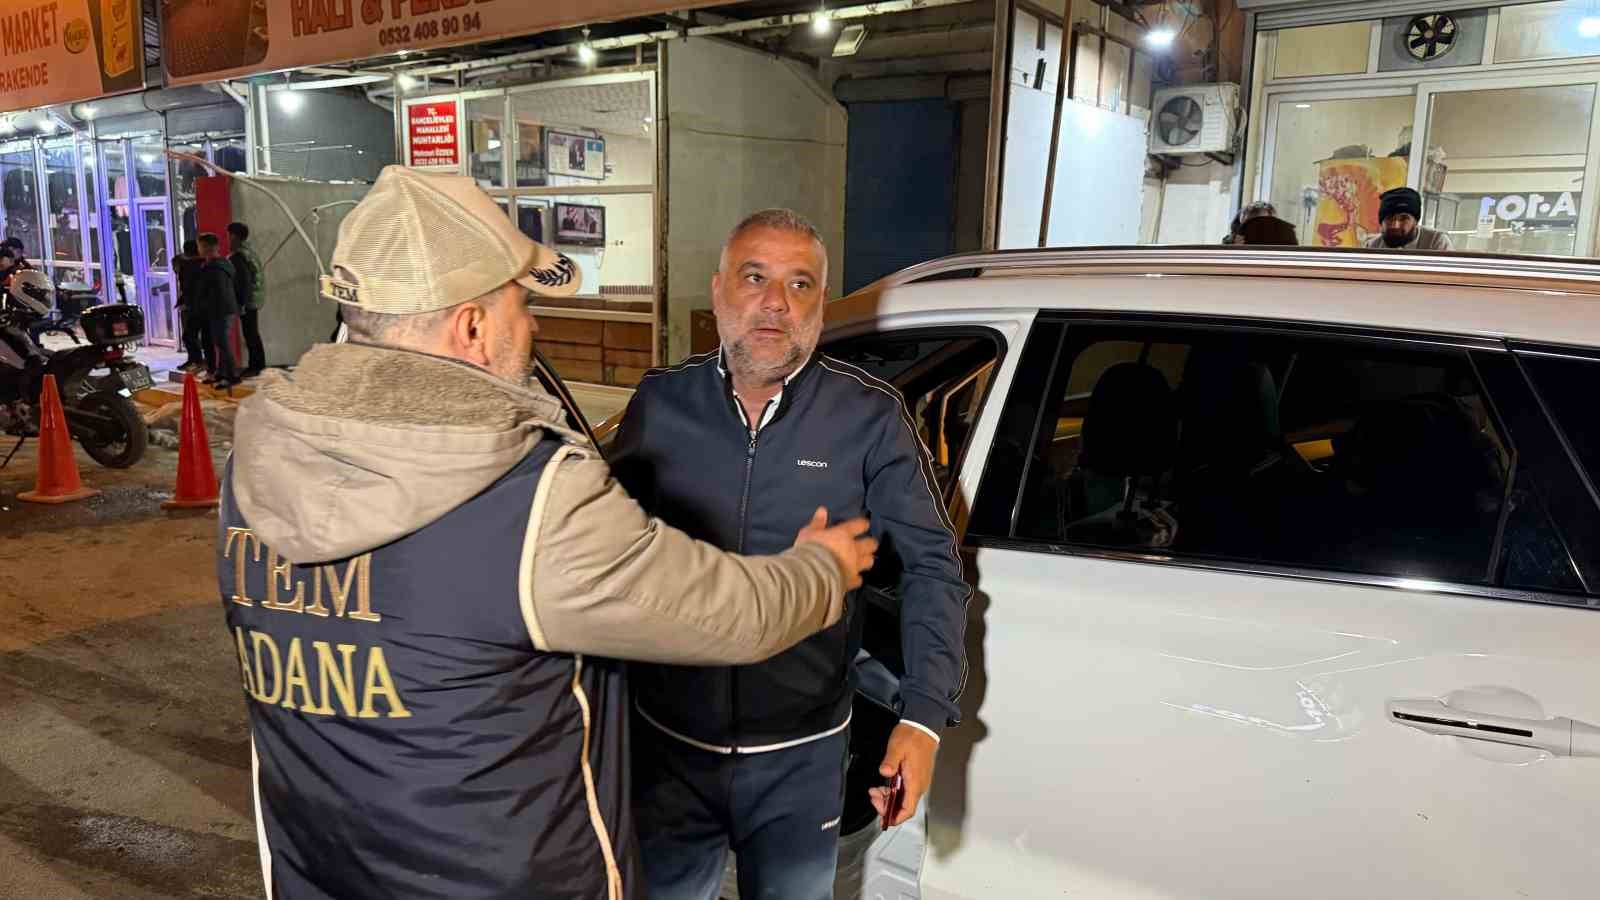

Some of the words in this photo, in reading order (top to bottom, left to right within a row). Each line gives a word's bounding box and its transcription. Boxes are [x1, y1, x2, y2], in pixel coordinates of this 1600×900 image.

[2, 2, 58, 57] MARKET
[379, 25, 411, 47] 0532
[413, 19, 439, 41] 408
[442, 15, 459, 37] 90
[463, 11, 481, 32] 94
[330, 282, 359, 303] TEM
[224, 526, 382, 623] TEM
[235, 626, 412, 719] ADANA
